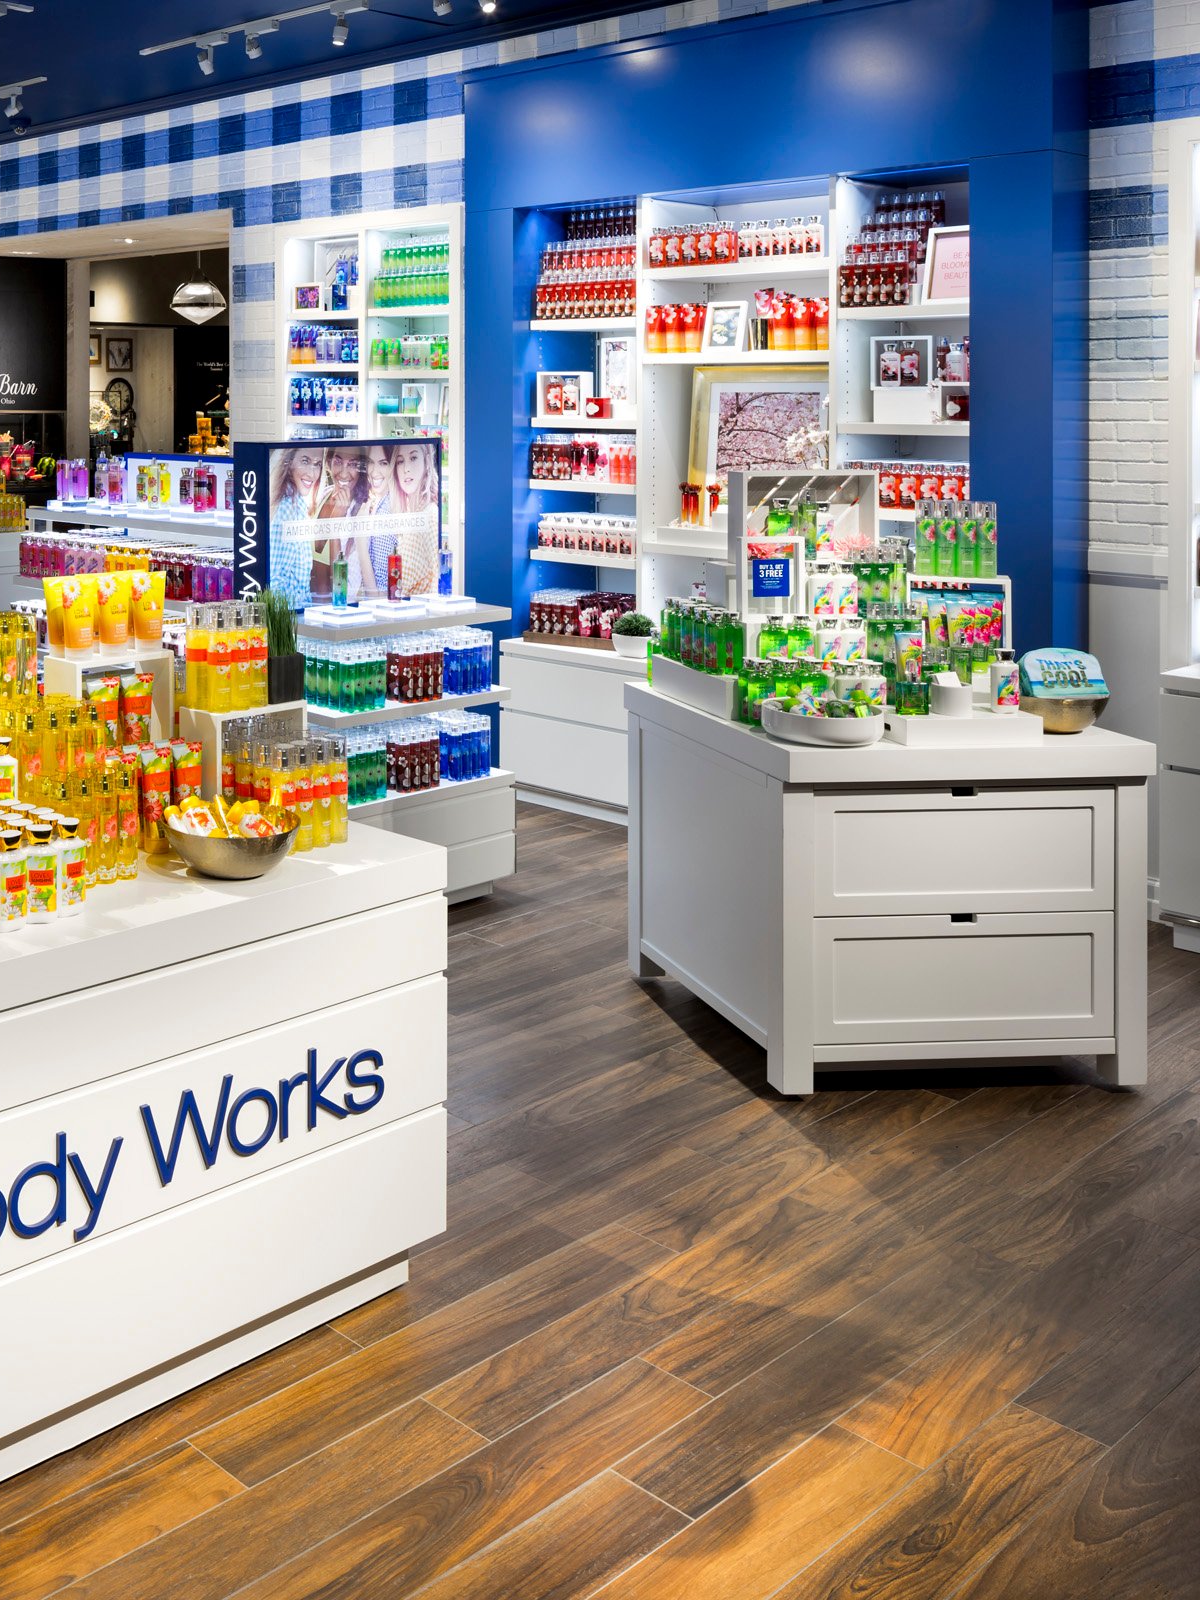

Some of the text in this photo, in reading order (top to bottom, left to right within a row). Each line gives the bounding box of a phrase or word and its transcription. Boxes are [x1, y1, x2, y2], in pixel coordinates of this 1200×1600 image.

[238, 470, 257, 568] Works
[286, 516, 426, 537] AMERICA'S FAVORITE FRAGRANCES
[1036, 658, 1087, 671] THAT'S
[1041, 669, 1093, 689] COOL
[138, 1047, 385, 1187] Works
